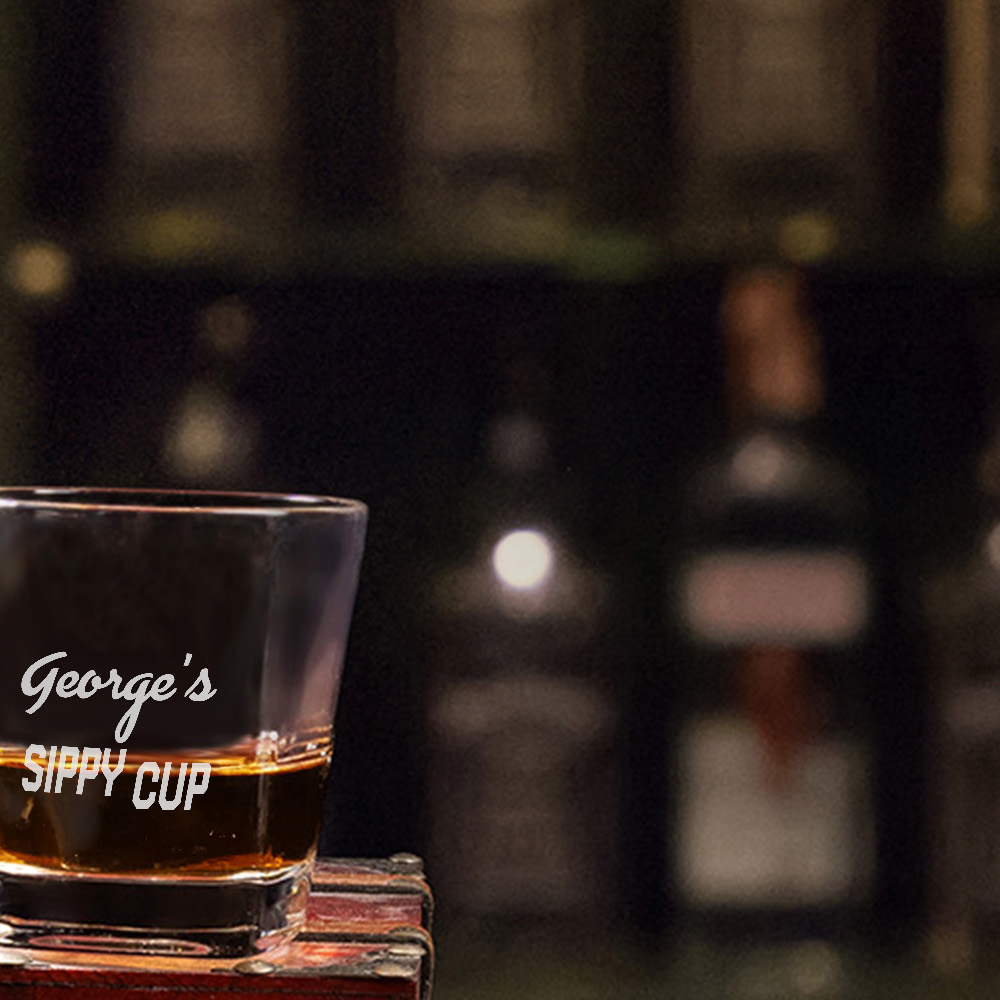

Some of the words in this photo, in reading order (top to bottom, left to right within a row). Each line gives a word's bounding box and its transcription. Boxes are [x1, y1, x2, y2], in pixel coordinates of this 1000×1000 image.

[21, 652, 217, 743] George's
[22, 744, 127, 796] SIPPY
[132, 762, 211, 810] CUP
